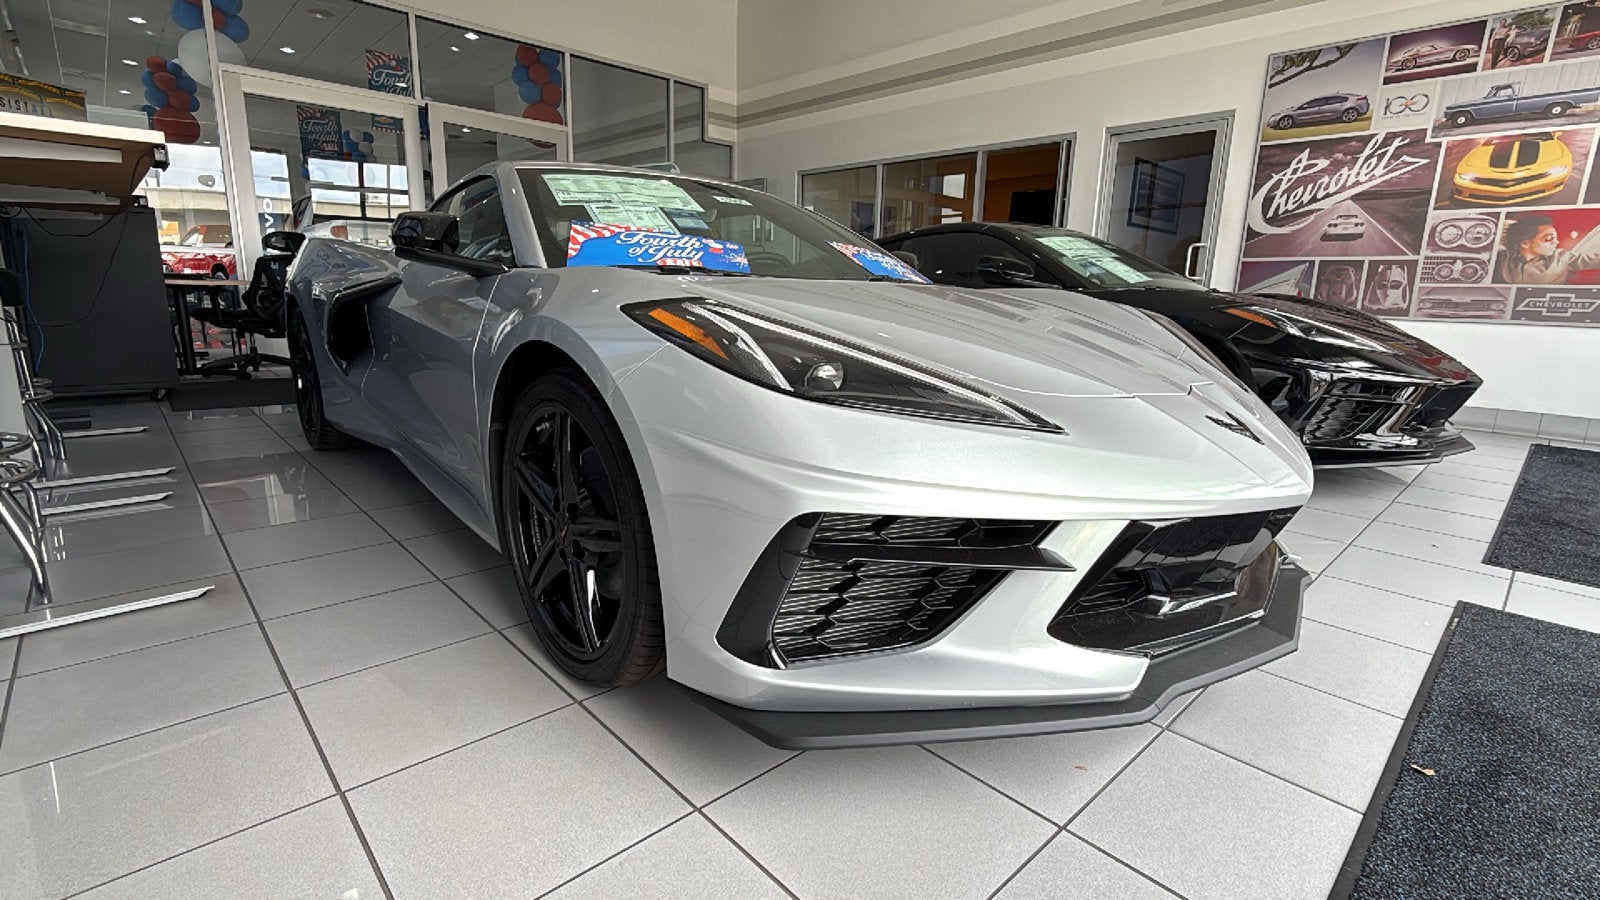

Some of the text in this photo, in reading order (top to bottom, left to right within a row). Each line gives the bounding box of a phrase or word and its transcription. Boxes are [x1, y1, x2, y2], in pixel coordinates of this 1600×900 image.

[1383, 93, 1430, 115] 100
[302, 119, 338, 132] Fourth
[1247, 131, 1430, 234] Chevrolet
[616, 231, 704, 249] Fourth
[628, 244, 704, 263] of July
[1529, 301, 1590, 309] CHEVROLET
